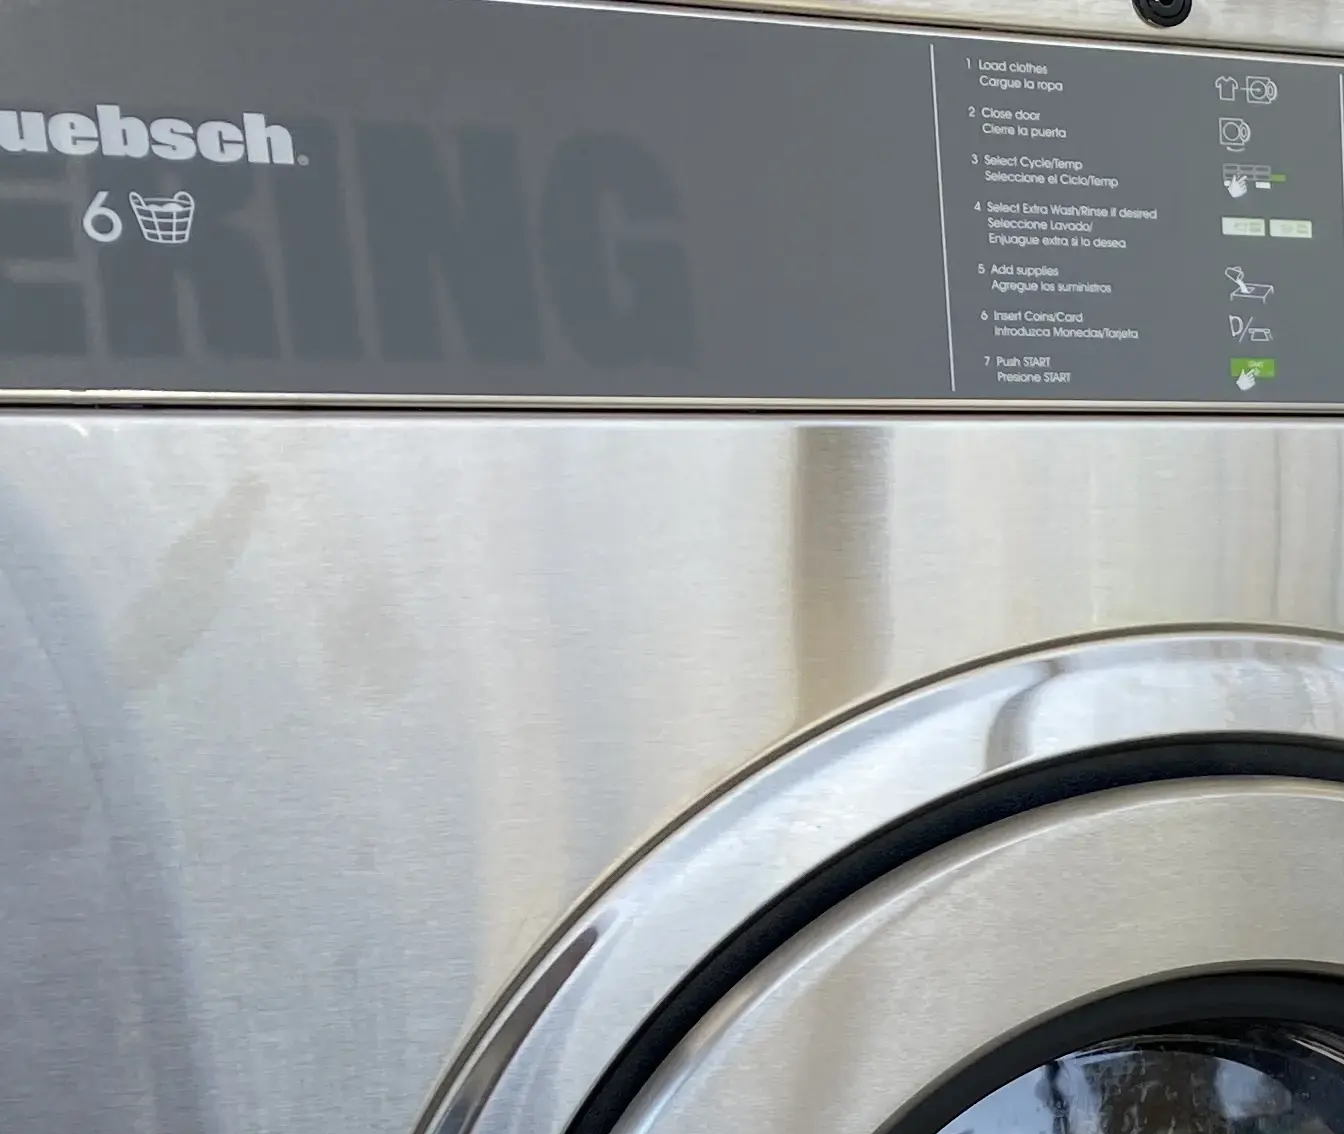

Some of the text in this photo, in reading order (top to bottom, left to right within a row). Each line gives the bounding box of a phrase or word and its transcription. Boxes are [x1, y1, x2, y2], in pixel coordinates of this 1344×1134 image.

[966, 58, 1048, 74] 1 Load clothes
[979, 75, 1063, 92] Cargue la ropa
[968, 106, 1040, 121] 2 Close door
[982, 123, 1067, 138] Cierre la puerta
[971, 154, 1083, 171] 3 Select Cycle/Temp
[985, 170, 1118, 189] Seleccione el Ciclo/Temp
[82, 191, 123, 243] 6
[974, 201, 981, 211] 4
[987, 201, 1020, 213] Select
[1023, 203, 1048, 215] Extra
[1050, 204, 1108, 217] Wash/Rinse
[1118, 208, 1157, 219] desired
[988, 217, 1048, 230] Seleccione
[989, 233, 1039, 247] Enjuague
[1042, 235, 1068, 246] extra
[1081, 237, 1090, 247] lo
[1093, 237, 1126, 248] desea
[978, 263, 1058, 277] 5 Add supplies
[991, 280, 1112, 293] Agregue los suministros
[980, 310, 1083, 323] 6 Insert Coins/Card
[995, 326, 1050, 337] Introduzca
[984, 356, 1051, 367] 7 Push START
[997, 372, 1072, 382] Presione START
